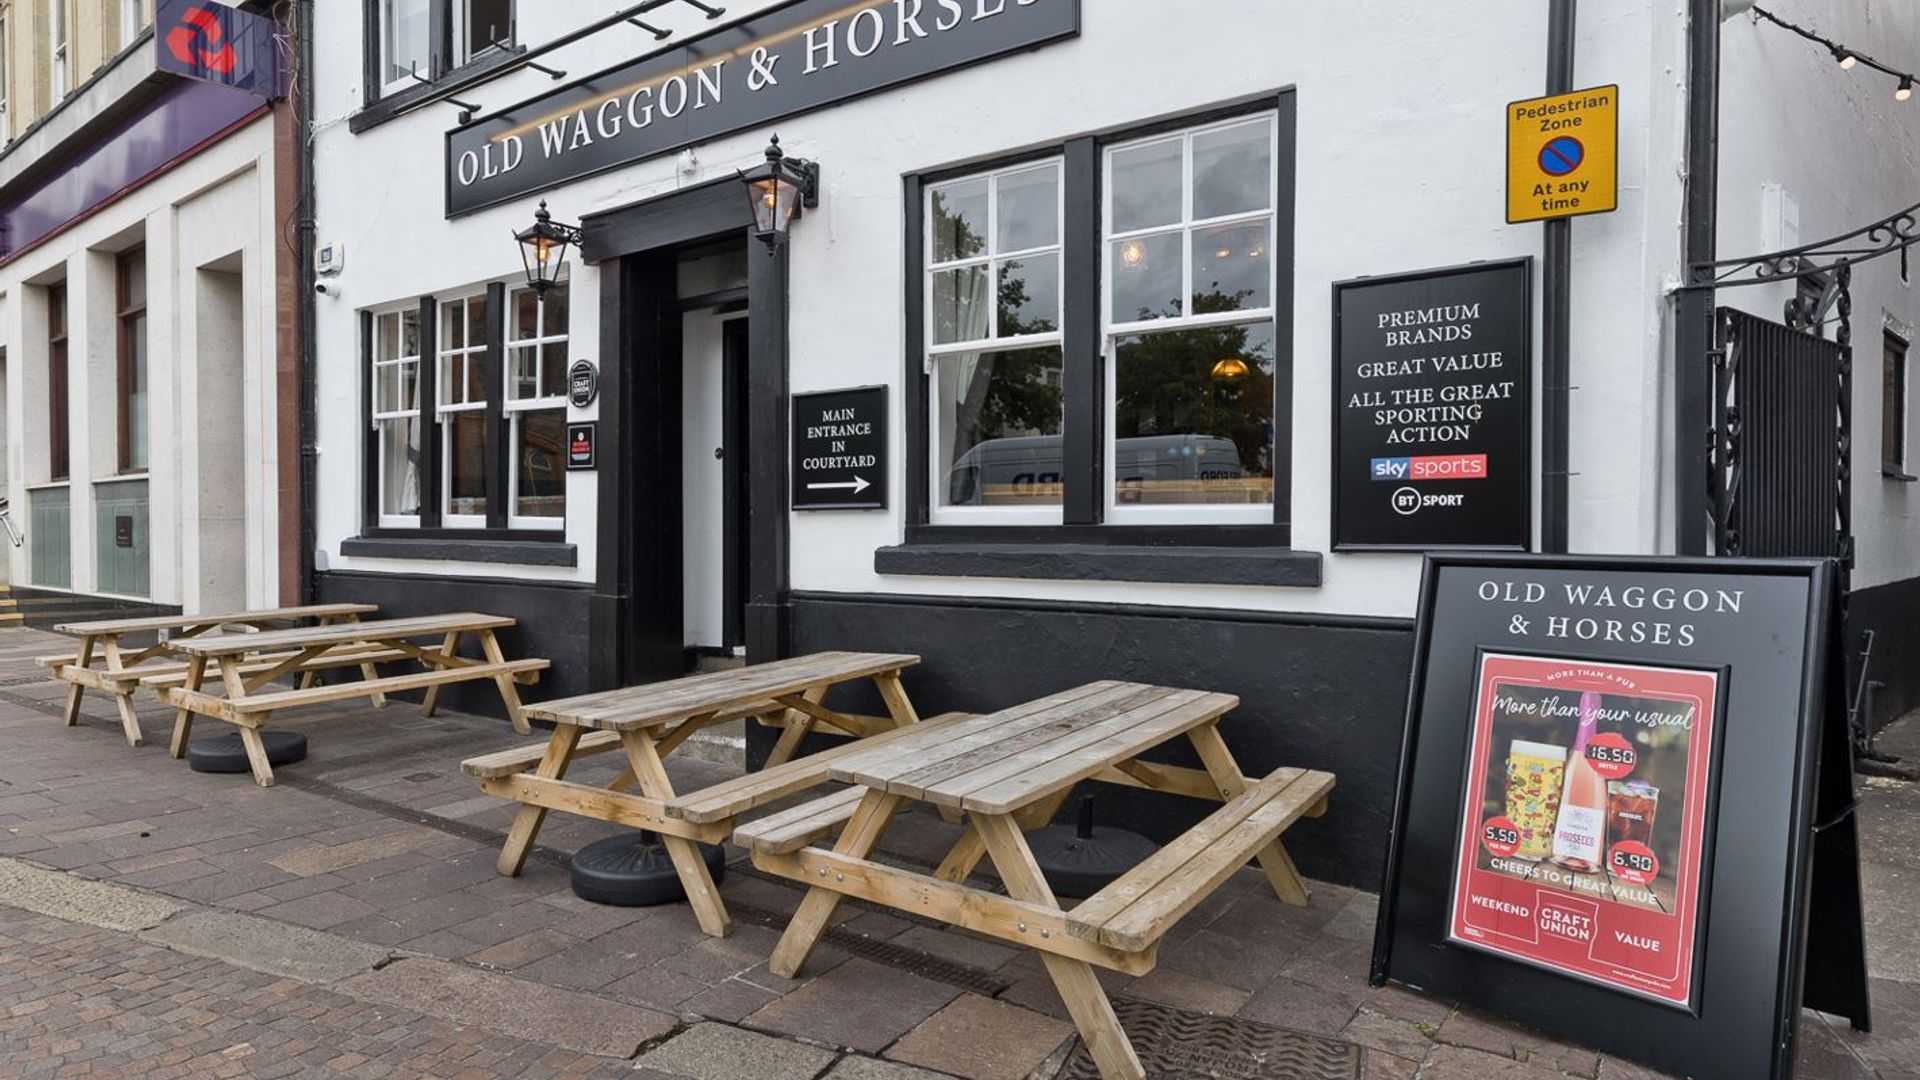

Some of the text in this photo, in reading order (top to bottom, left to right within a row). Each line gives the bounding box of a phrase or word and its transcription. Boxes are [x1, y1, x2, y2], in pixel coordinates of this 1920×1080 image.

[458, 0, 1037, 187] OLD WAGGON & HORS
[1516, 96, 1609, 120] Pedestrian
[1540, 116, 1582, 132] Zone
[1532, 180, 1589, 197] At any
[1541, 197, 1579, 211] time
[1378, 303, 1480, 328] PREMIUM
[1386, 324, 1472, 347] BRANDS
[1357, 352, 1503, 378] GREAT VALUE
[1348, 382, 1514, 408] ALL THE GREAT
[822, 408, 855, 422] MAIN
[1375, 404, 1482, 425] SPORTING
[807, 423, 871, 438] ENTRANCE
[1387, 425, 1470, 444] ACTION
[832, 440, 845, 453] IN
[803, 455, 876, 470] COURTYARD
[1375, 457, 1482, 478] sky sports
[1398, 495, 1464, 506] BT SPORT
[1478, 581, 1744, 613] OLD WAGGON
[1509, 614, 1695, 647] & HORSES
[1547, 670, 1575, 681] MORE
[1577, 669, 1604, 679] THAN
[1615, 678, 1636, 689] PUB
[1492, 695, 1696, 730] More than your usual
[1592, 746, 1633, 764] 16.50
[1486, 826, 1517, 844] 5.50
[1614, 851, 1652, 871] 6.90
[1490, 858, 1540, 878] CHEERS
[1543, 869, 1561, 882] TO
[1563, 872, 1606, 892] GREAT
[1611, 885, 1658, 905] VALUE
[1472, 894, 1529, 917] WEEKEND
[1541, 908, 1591, 928] CRAFT
[1540, 918, 1590, 940] UNION
[1614, 931, 1660, 952] VALUE
